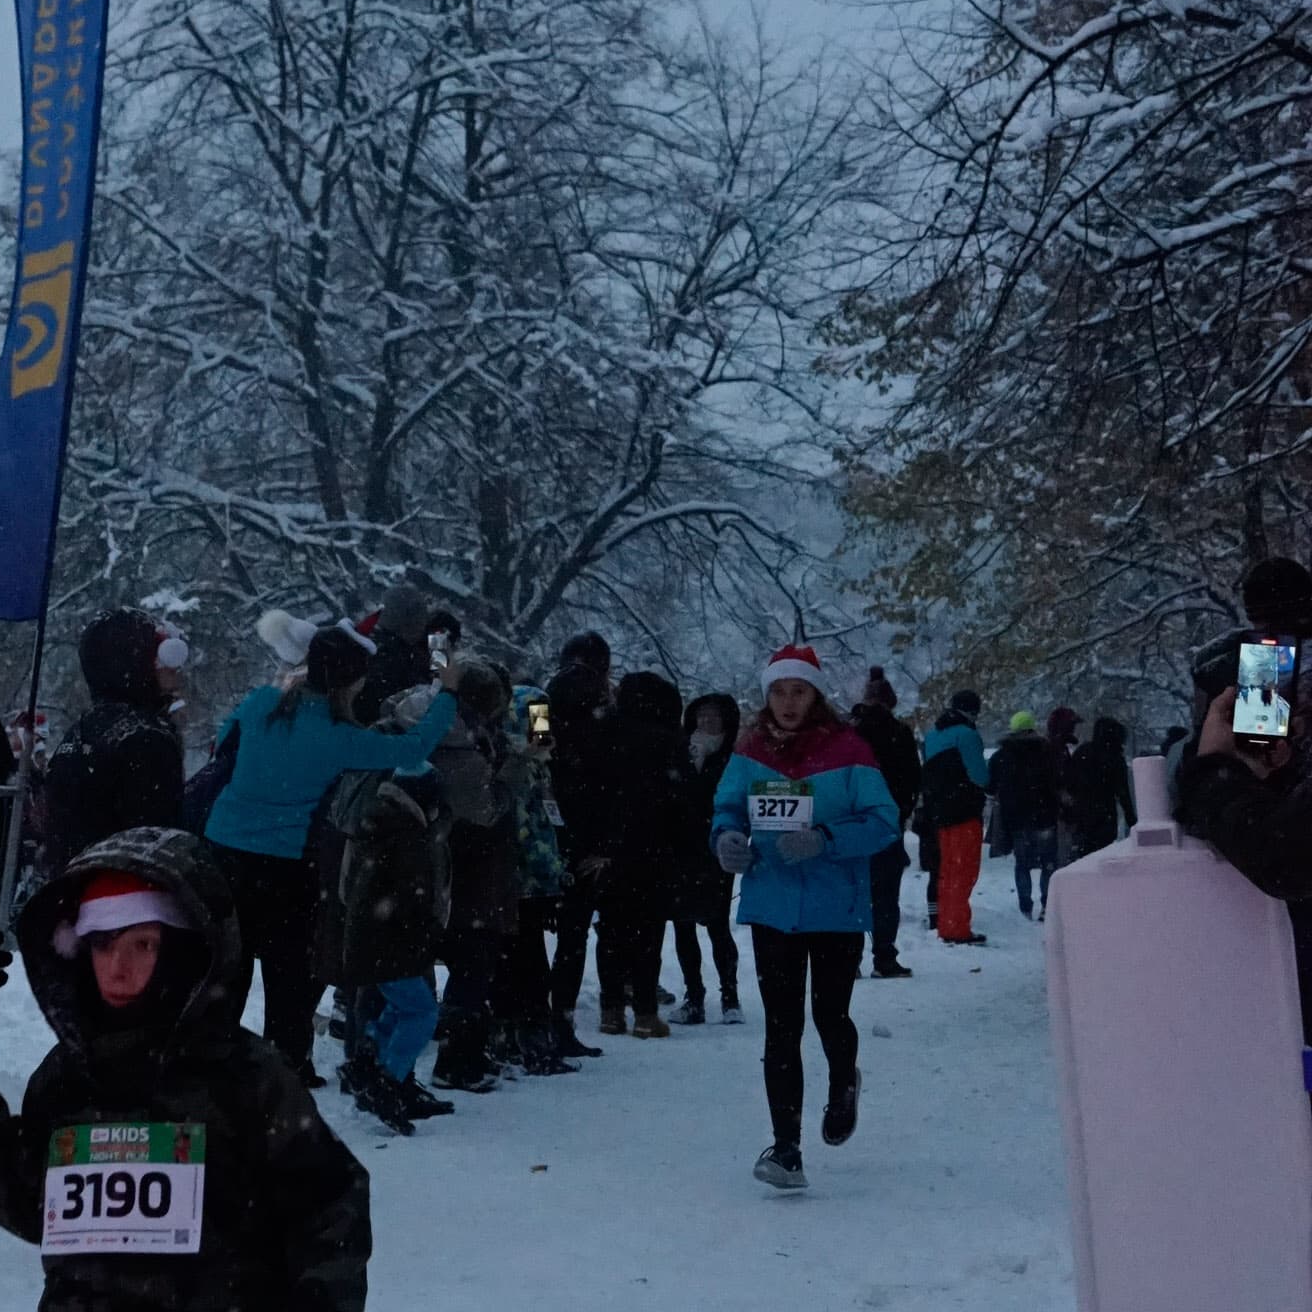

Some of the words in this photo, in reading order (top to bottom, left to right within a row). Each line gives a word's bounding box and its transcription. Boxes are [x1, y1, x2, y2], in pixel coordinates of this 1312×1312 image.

[757, 798, 799, 817] 3217
[111, 1127, 150, 1143] KIDS
[62, 1171, 172, 1220] 3190
